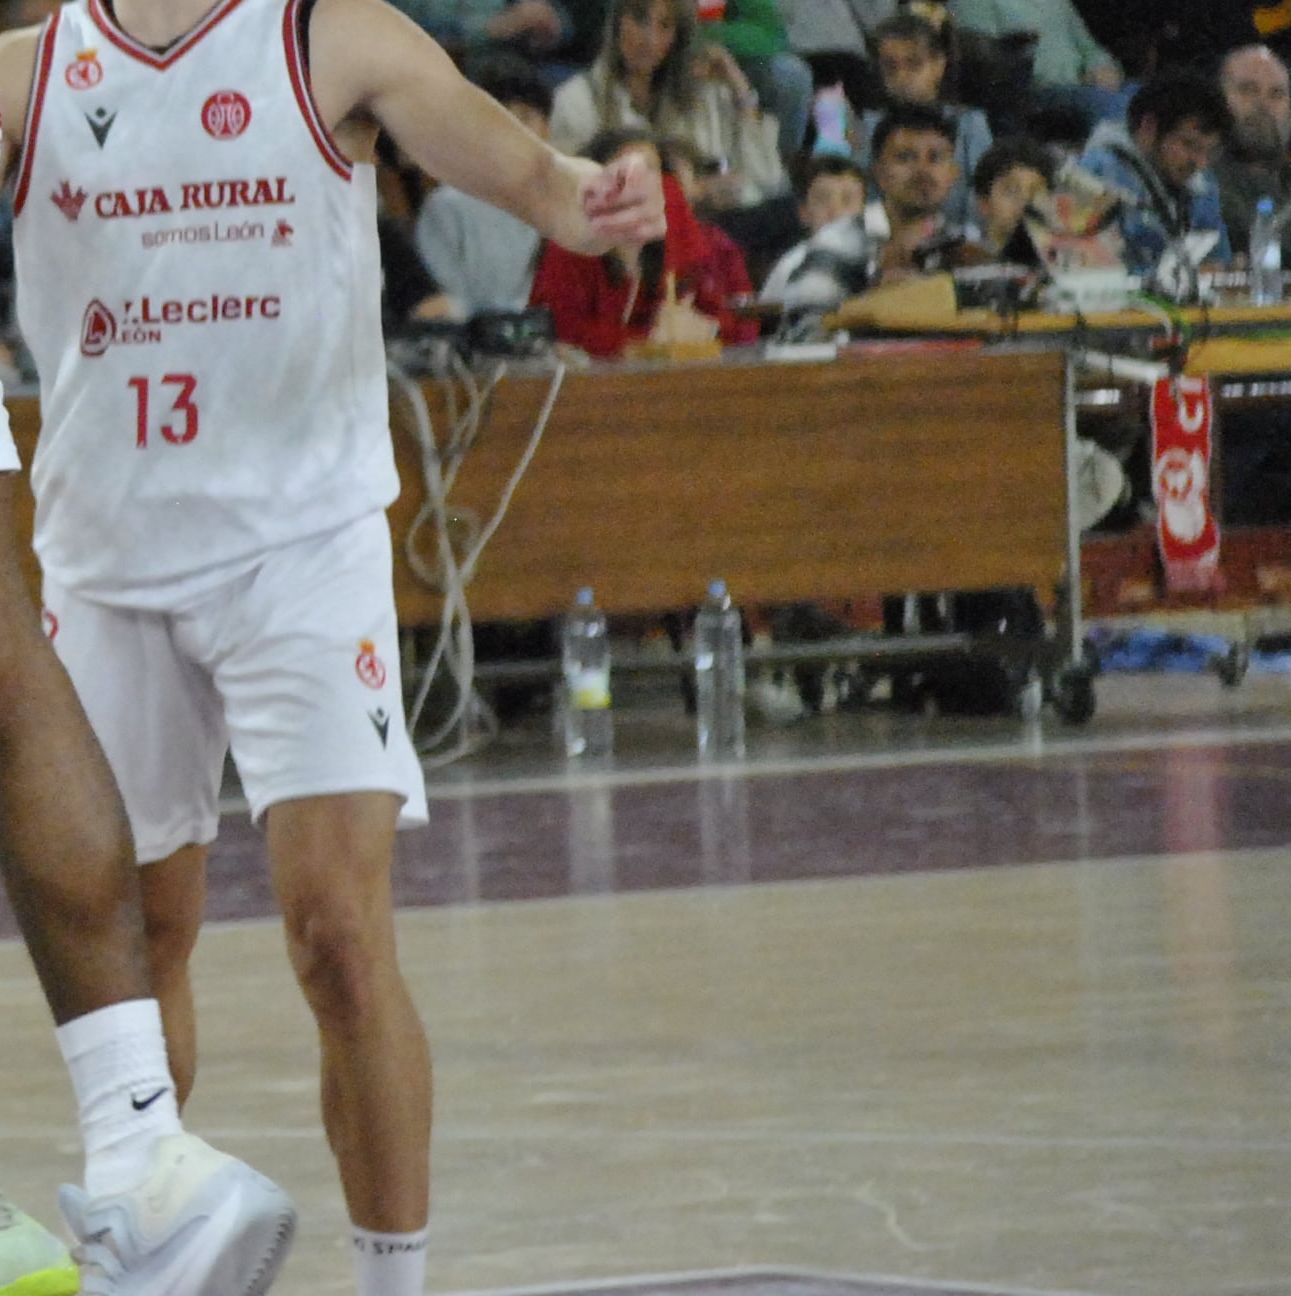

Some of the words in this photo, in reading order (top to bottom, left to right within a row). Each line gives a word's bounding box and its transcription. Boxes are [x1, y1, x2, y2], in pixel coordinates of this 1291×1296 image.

[94, 186, 173, 220] CAJA
[179, 176, 296, 211] RURAL
[127, 373, 200, 450] 13
